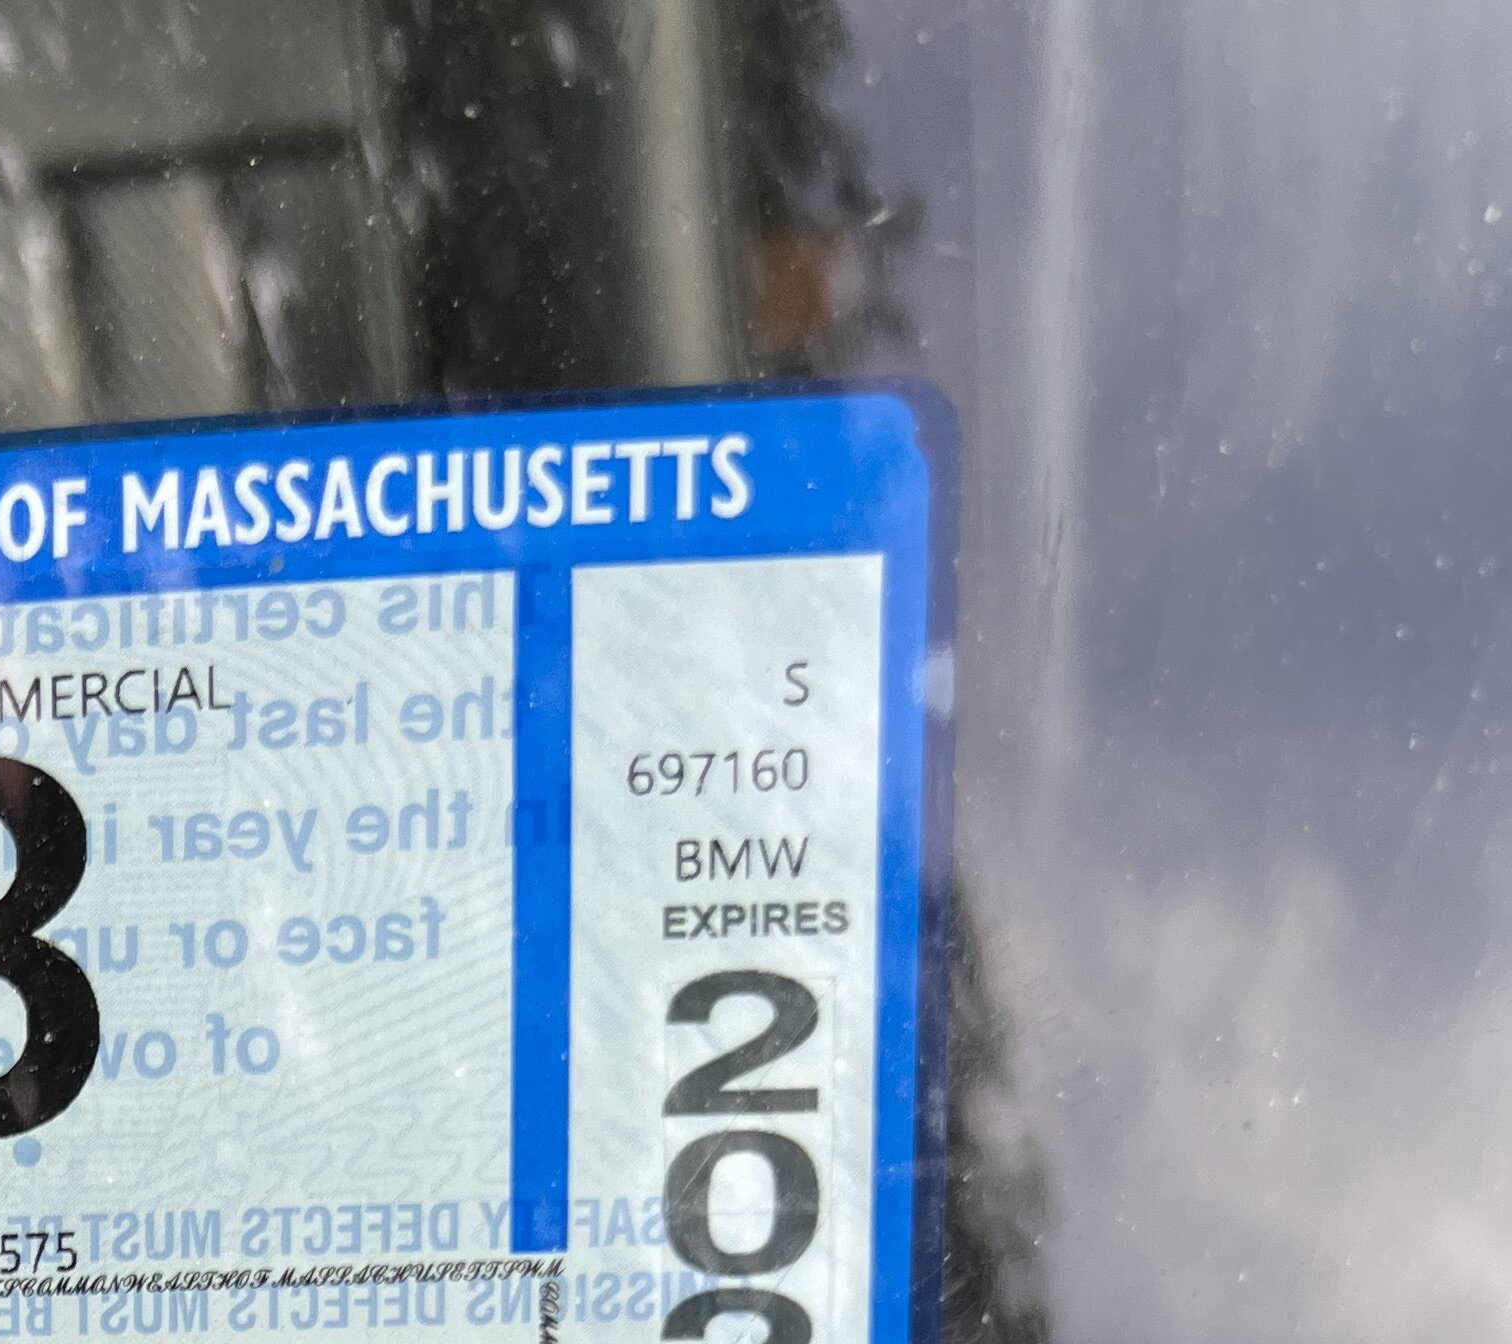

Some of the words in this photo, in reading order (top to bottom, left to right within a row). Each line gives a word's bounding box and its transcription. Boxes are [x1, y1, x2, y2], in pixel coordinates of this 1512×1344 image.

[122, 434, 750, 553] MASSACHUSETTS
[783, 662, 809, 707] S
[627, 748, 809, 797] 697160
[675, 837, 809, 883] BMW
[662, 901, 850, 940] EXPIRES
